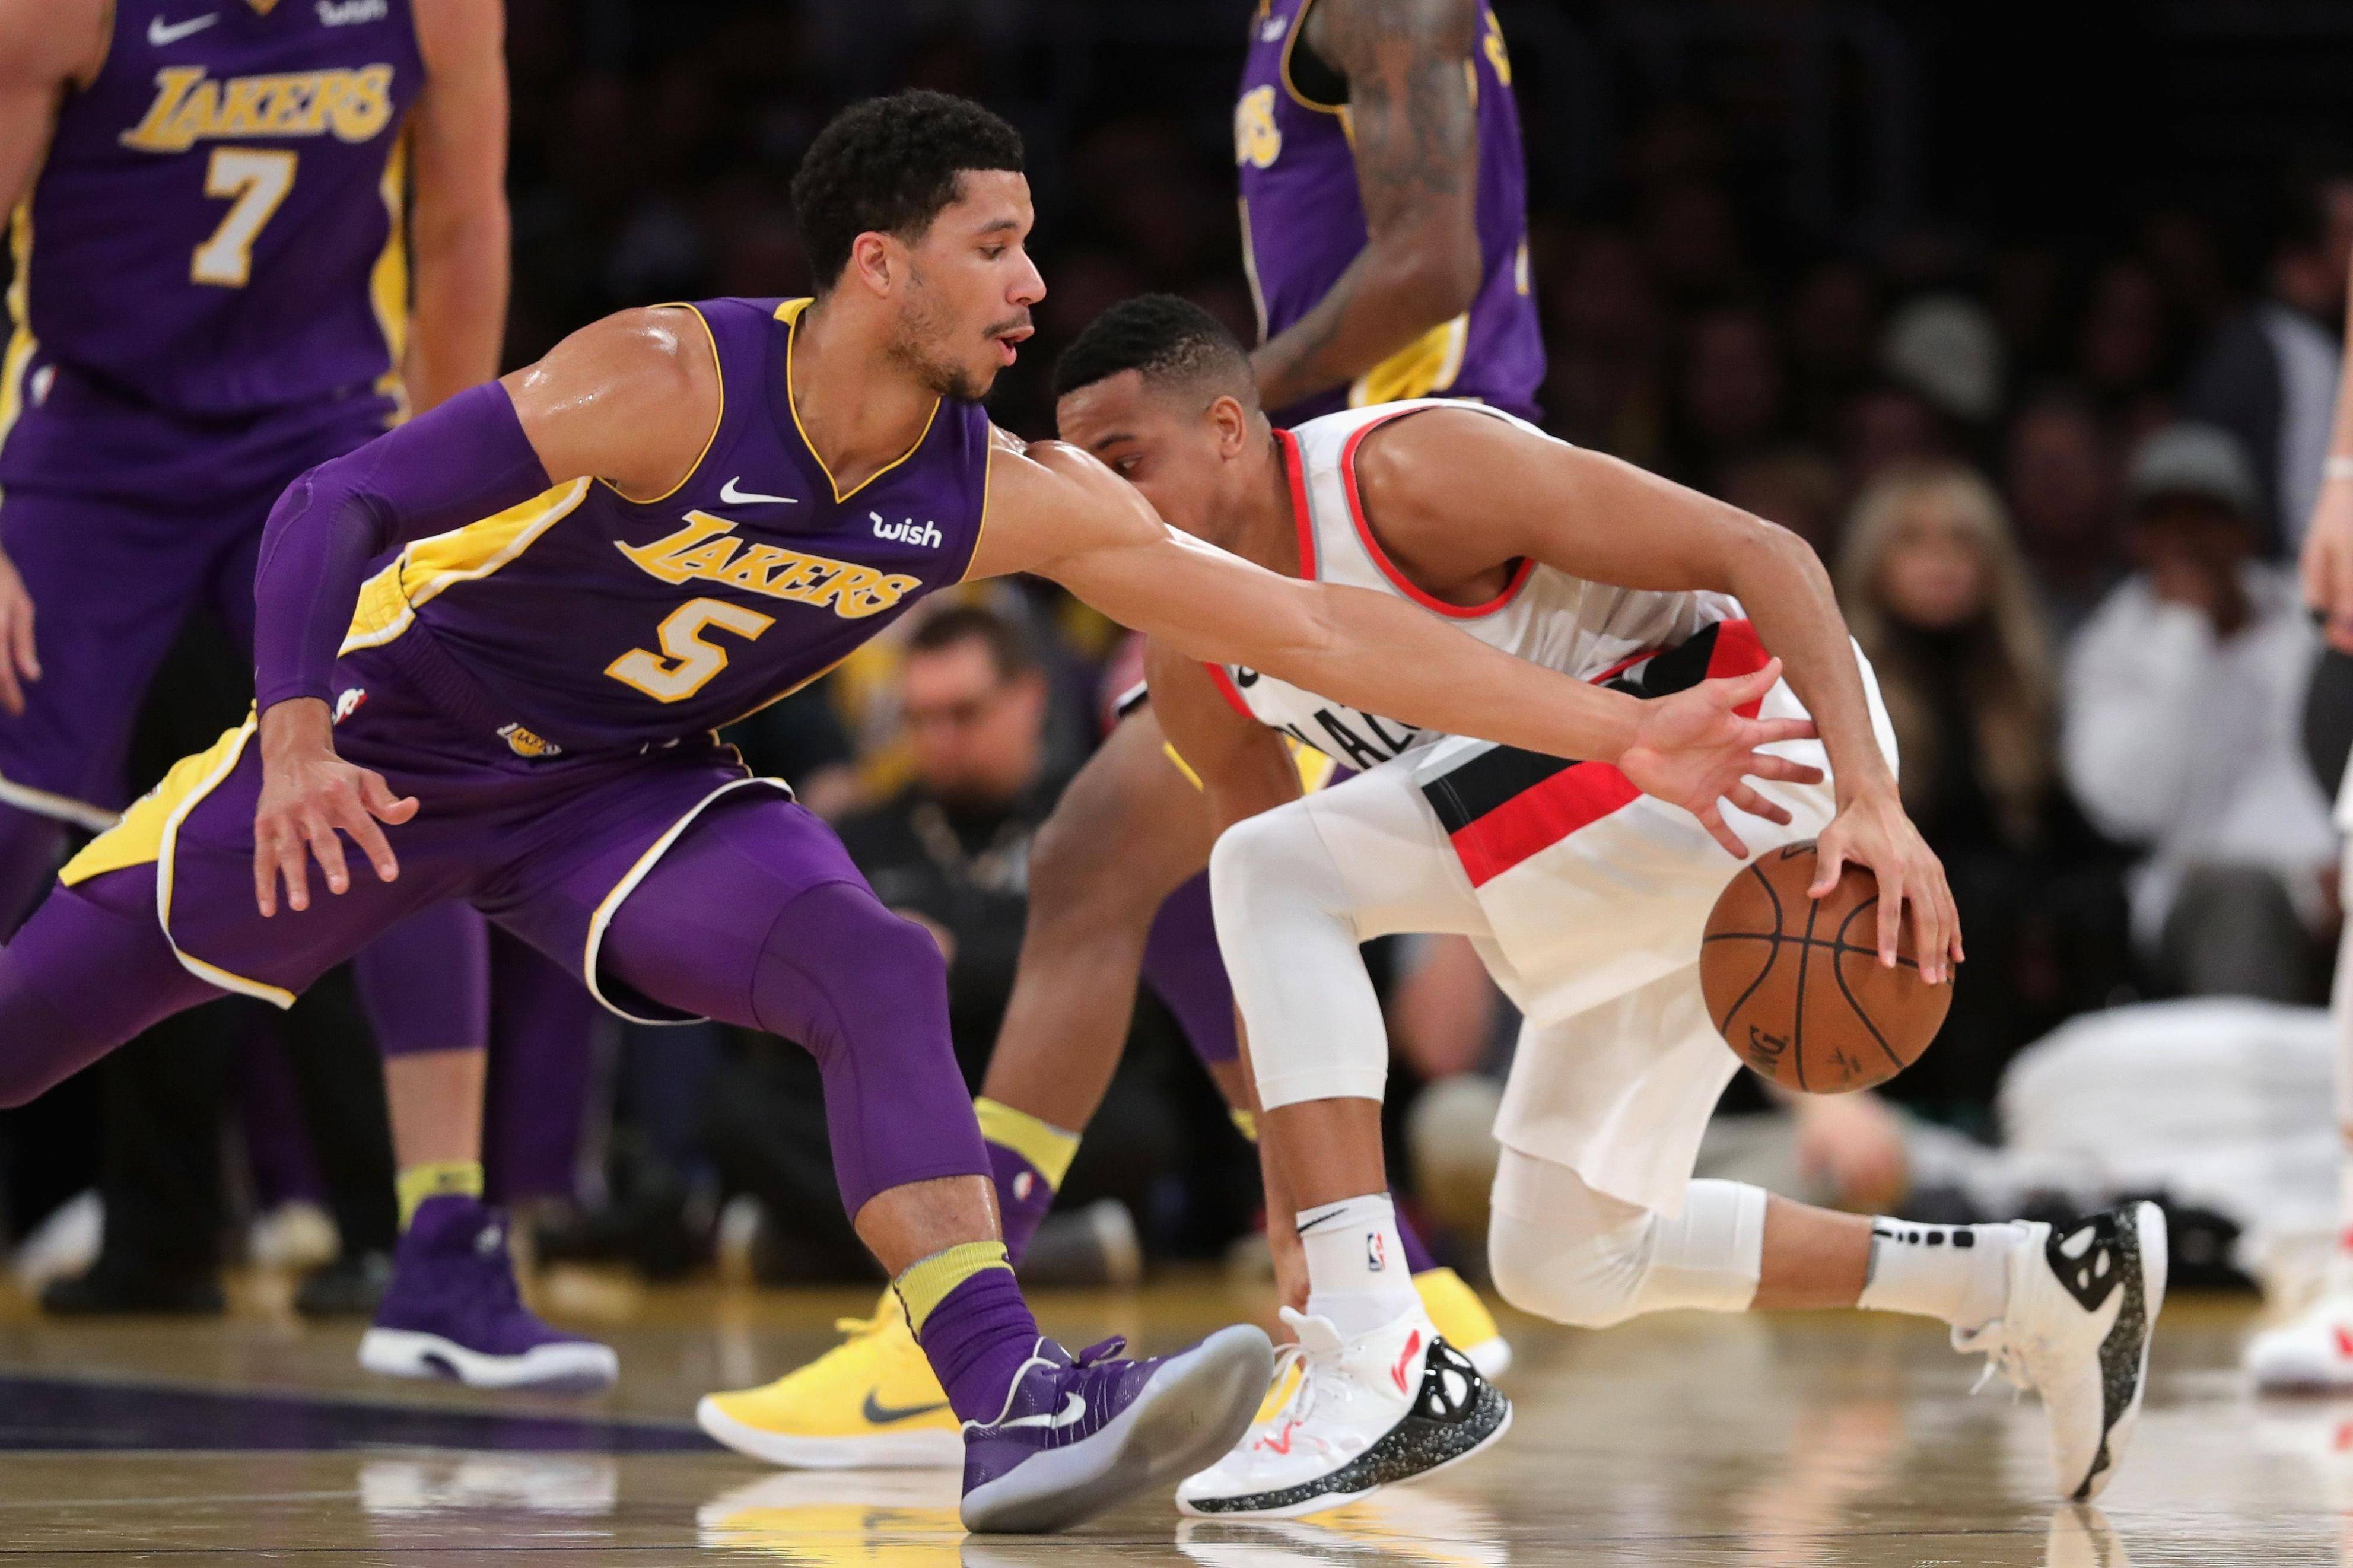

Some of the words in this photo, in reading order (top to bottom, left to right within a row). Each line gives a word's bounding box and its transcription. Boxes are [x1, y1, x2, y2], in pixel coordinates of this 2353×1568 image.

[120, 64, 394, 152] LAKERS
[190, 148, 298, 288] 7
[613, 509, 923, 619] LAKERS
[869, 511, 942, 548] wish
[603, 597, 776, 704] 5
